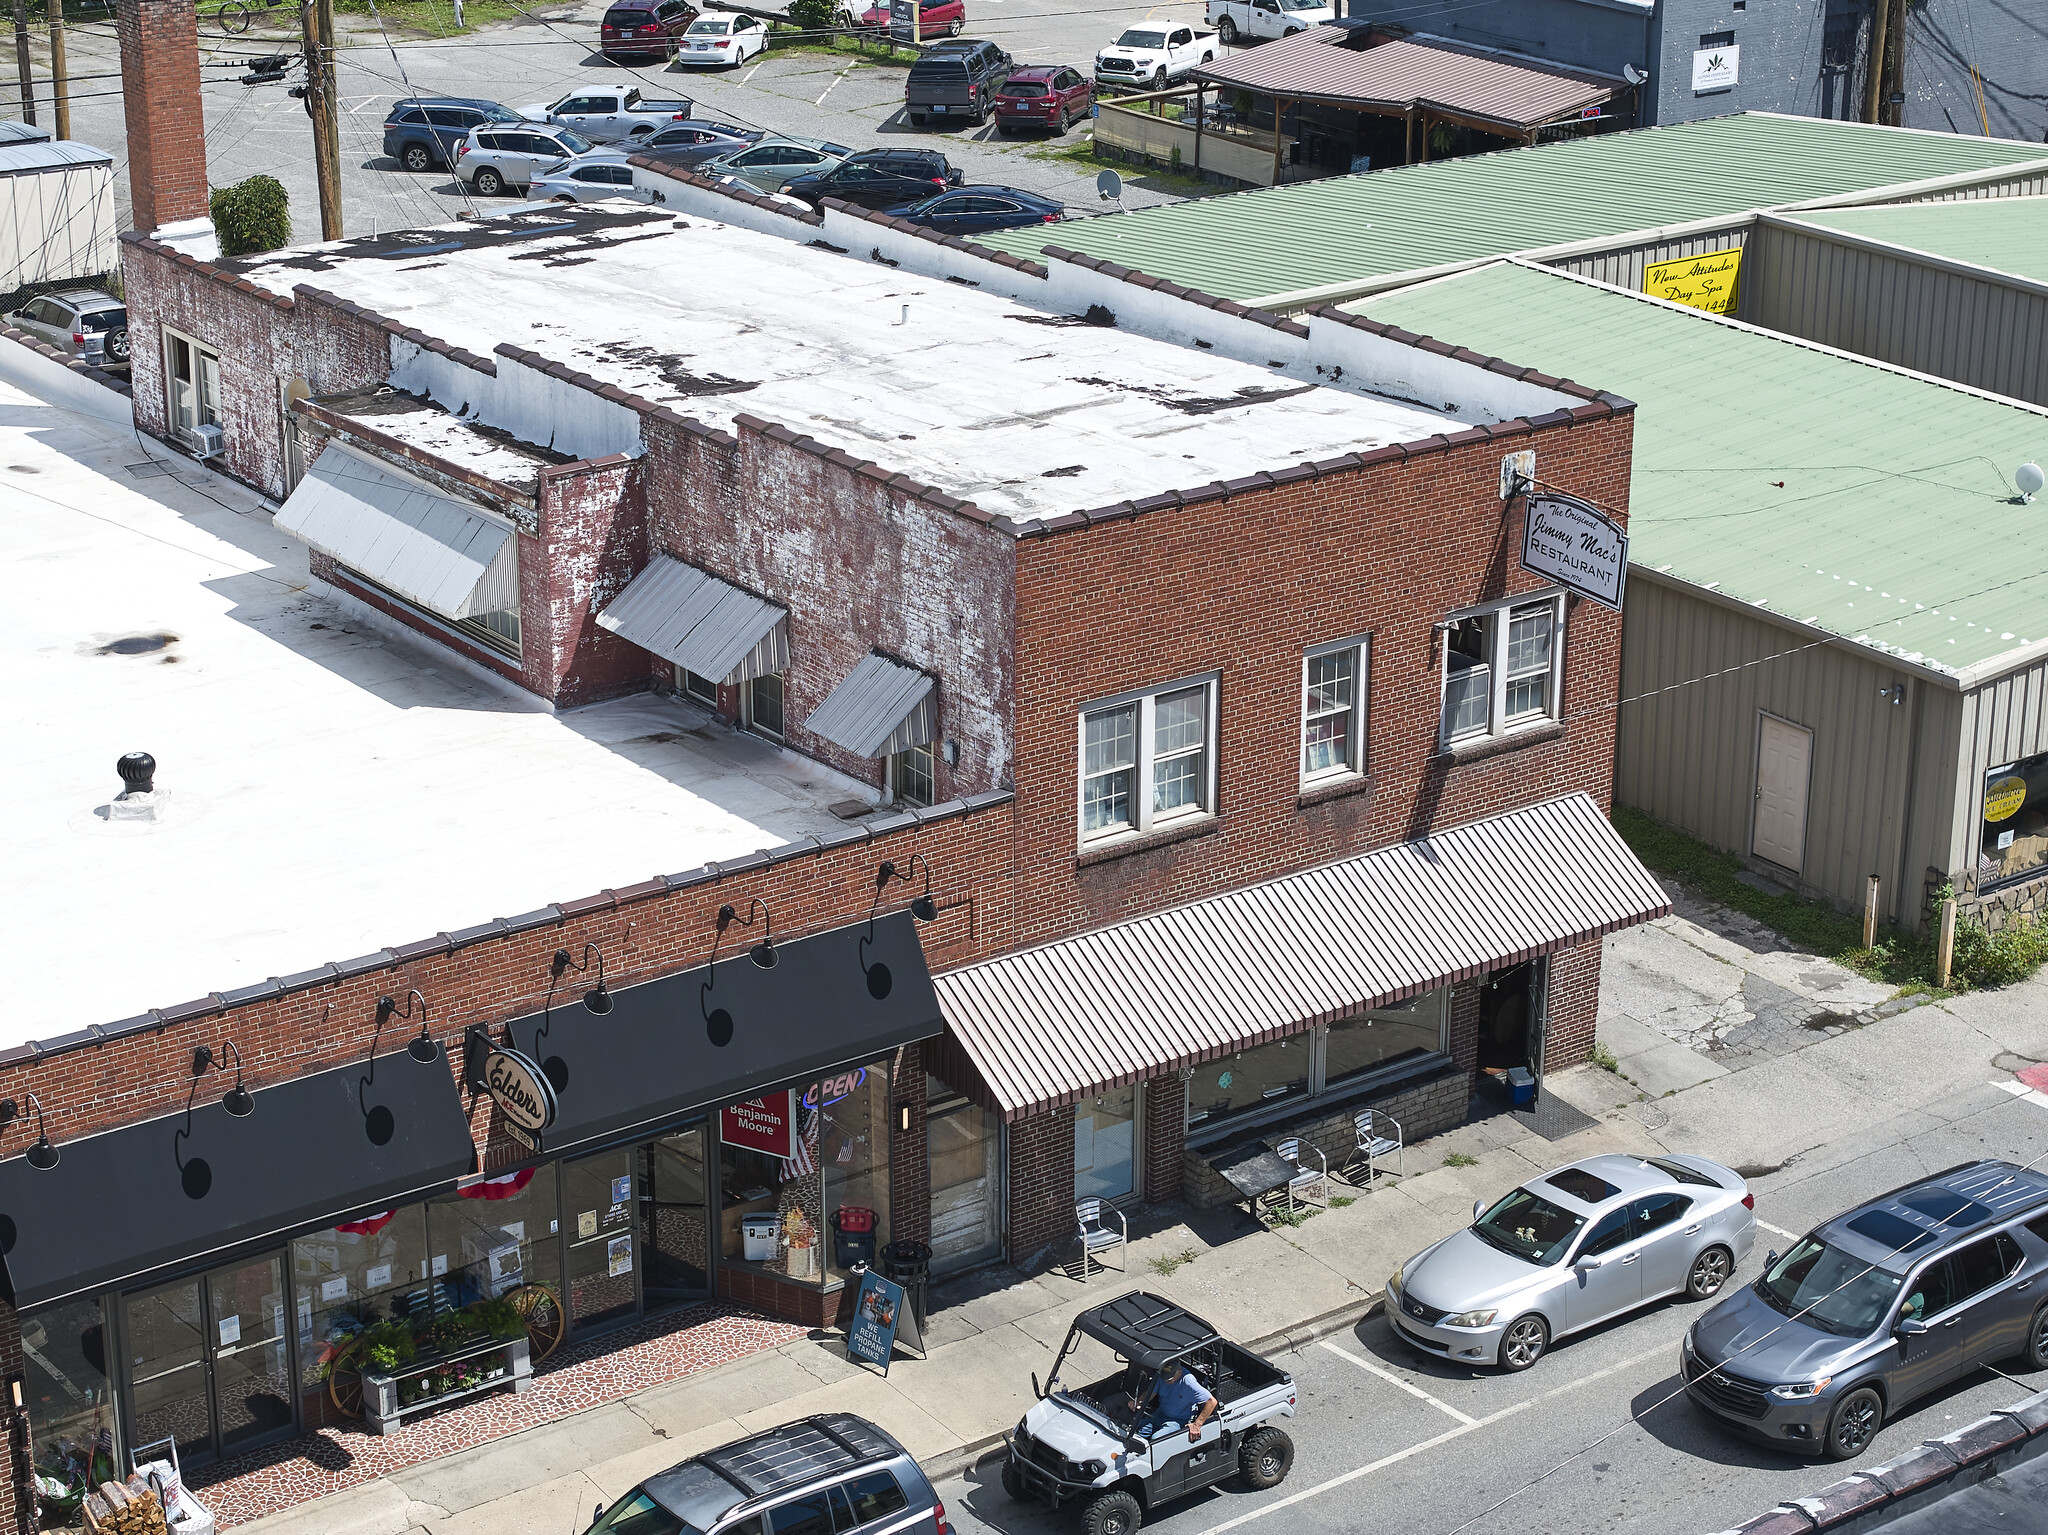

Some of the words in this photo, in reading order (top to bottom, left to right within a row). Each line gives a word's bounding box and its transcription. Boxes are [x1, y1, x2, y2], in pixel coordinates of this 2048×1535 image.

[1584, 108, 1600, 118] OPEN
[1653, 268, 1678, 284] New
[1682, 258, 1734, 279] Attitudes
[1664, 286, 1693, 301] Day
[1696, 279, 1723, 297] Spa
[1549, 504, 1563, 516] The
[1565, 508, 1598, 530] Original
[1532, 513, 1573, 549] Jimmy
[1580, 532, 1617, 563] Mac's
[1531, 538, 1613, 583] RESTAURANT
[806, 1071, 860, 1104] OPEN
[501, 1098, 514, 1112] ACE
[730, 1105, 781, 1125] Benjamin
[738, 1117, 774, 1135] Moore
[609, 1203, 623, 1212] ACE
[867, 1322, 879, 1331] WE
[854, 1333, 885, 1355] PROPANE
[860, 1328, 882, 1345] REFILL
[857, 1344, 879, 1360] TANKS
[1223, 1411, 1246, 1424] Kawasaki
